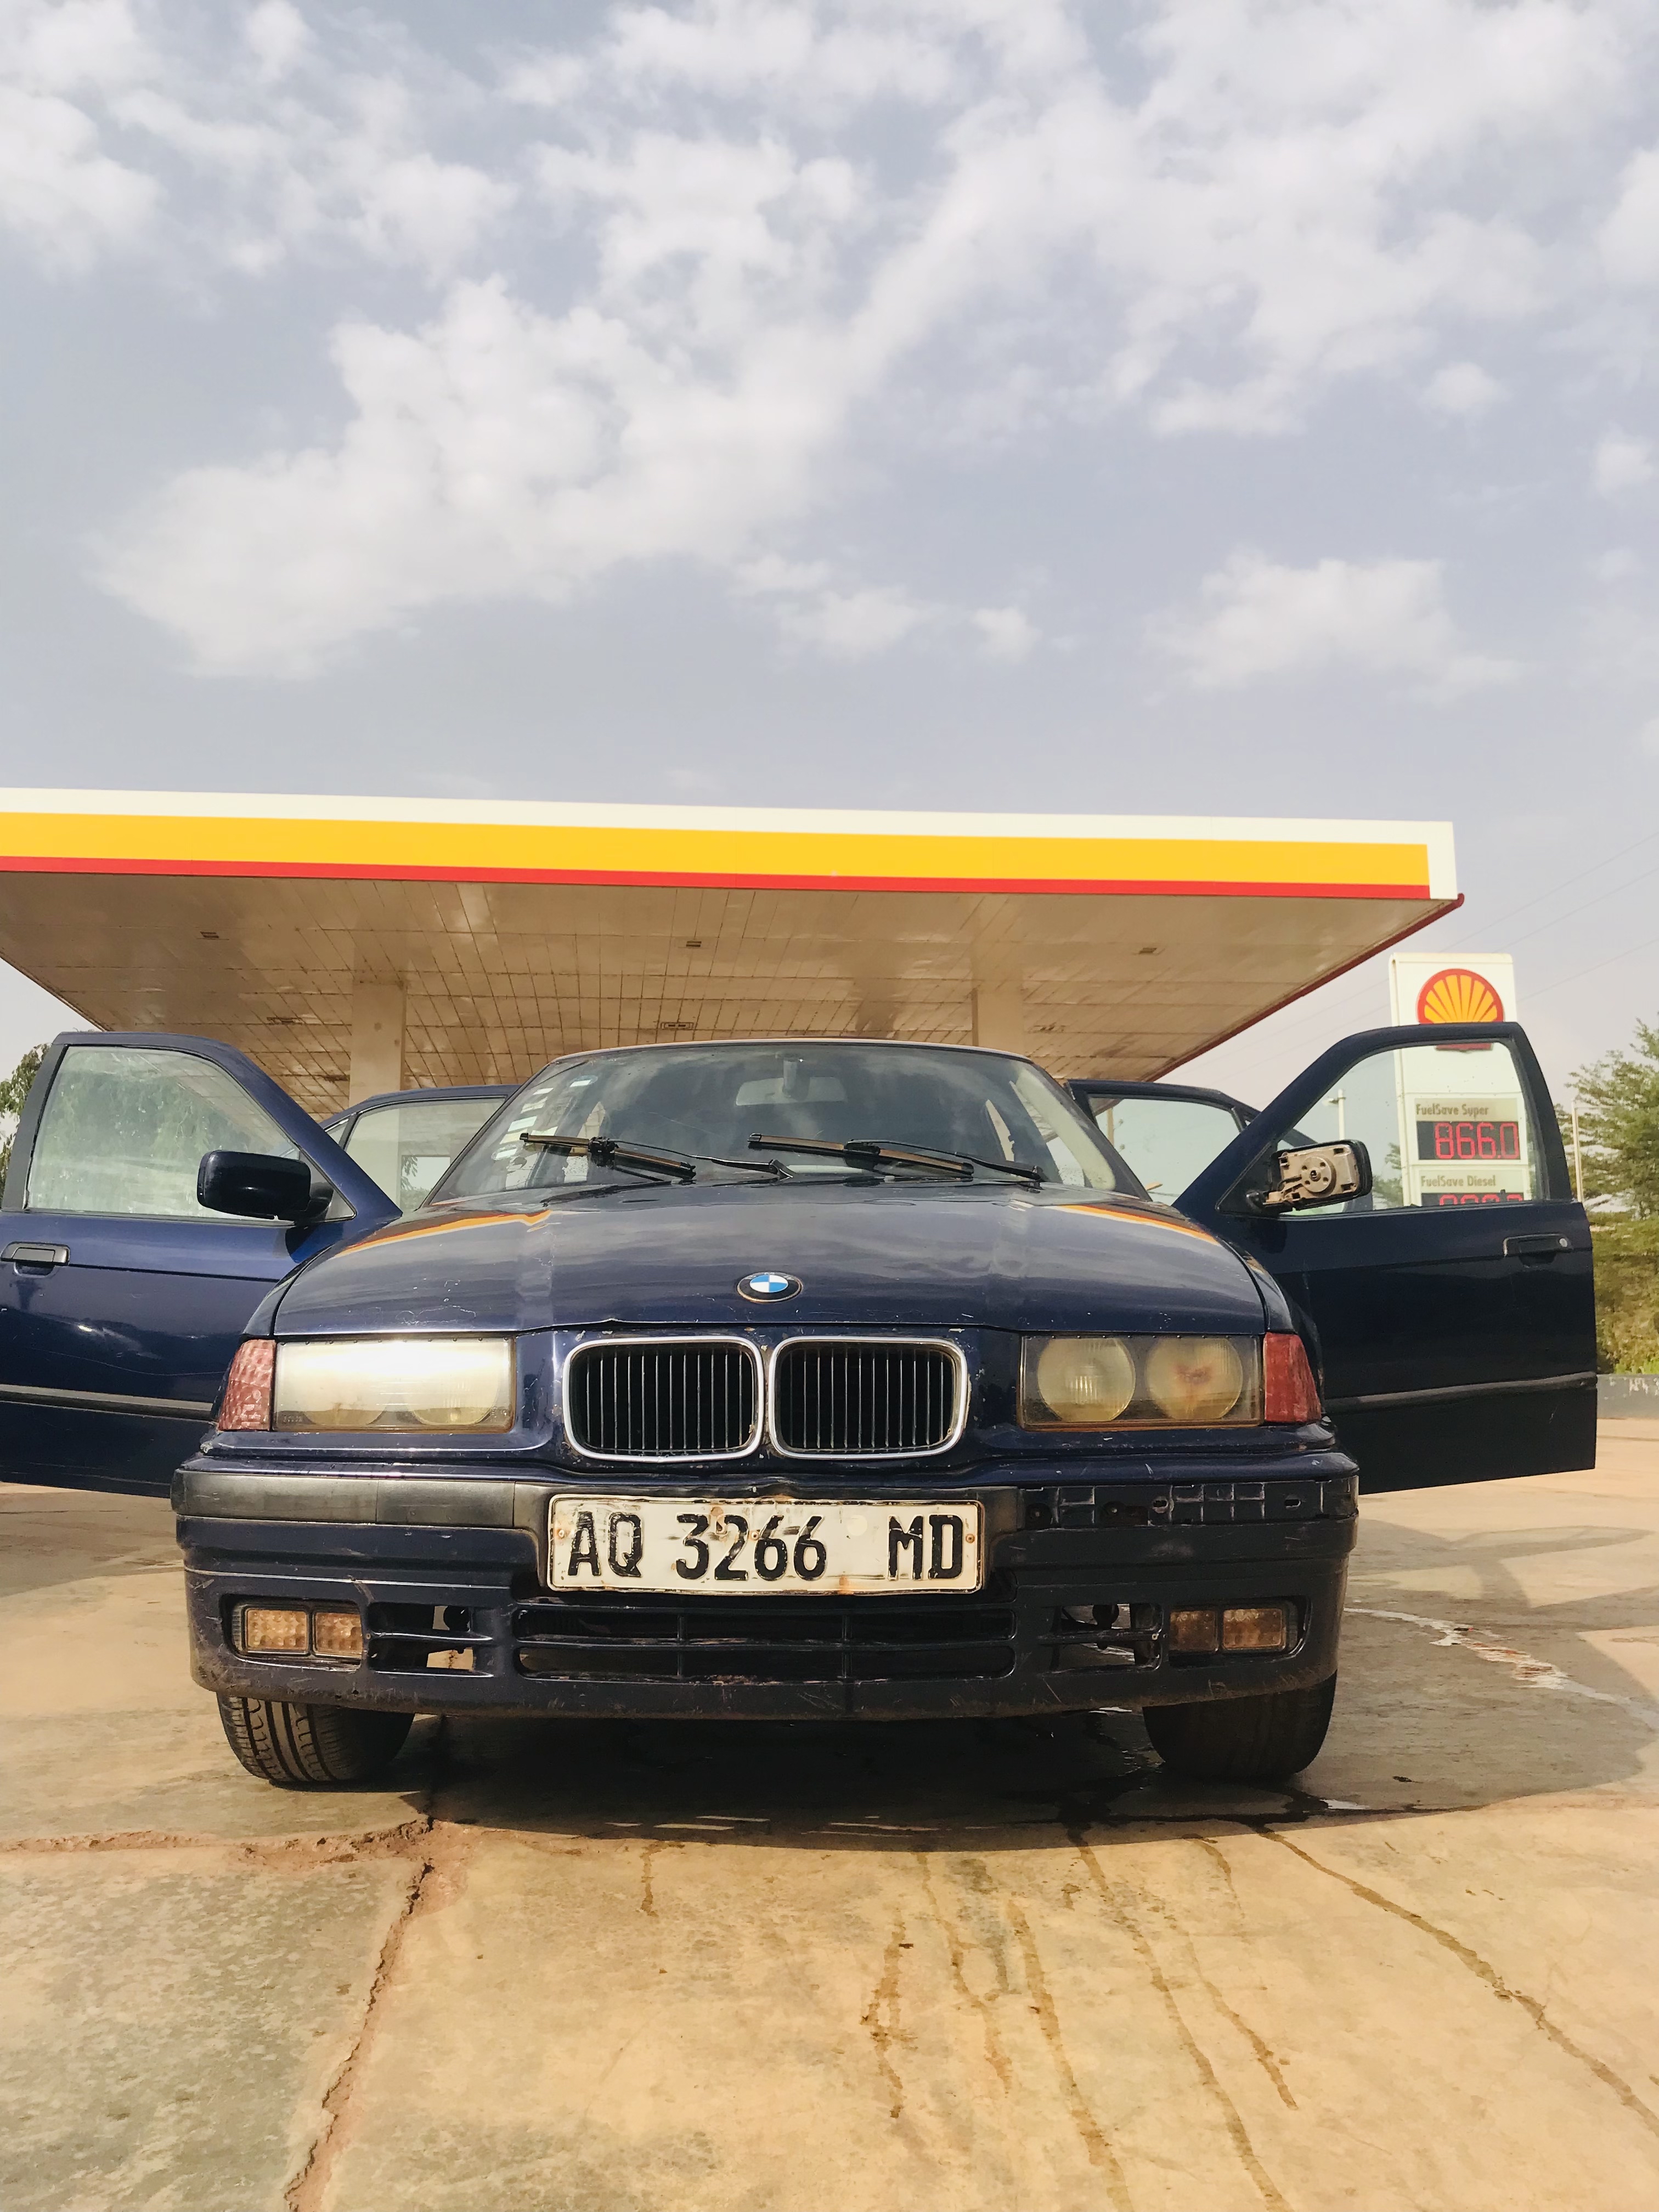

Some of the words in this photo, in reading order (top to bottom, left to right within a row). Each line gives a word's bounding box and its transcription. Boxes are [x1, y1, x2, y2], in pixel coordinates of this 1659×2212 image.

[1415, 1103, 1459, 1115] FuelSave
[1434, 1122, 1520, 1160] 866.0
[1420, 1175, 1464, 1187] FuelSave
[1466, 1174, 1497, 1187] Diesel
[567, 1511, 642, 1578] AQ
[675, 1513, 828, 1581] 3266
[887, 1513, 964, 1580] MD
